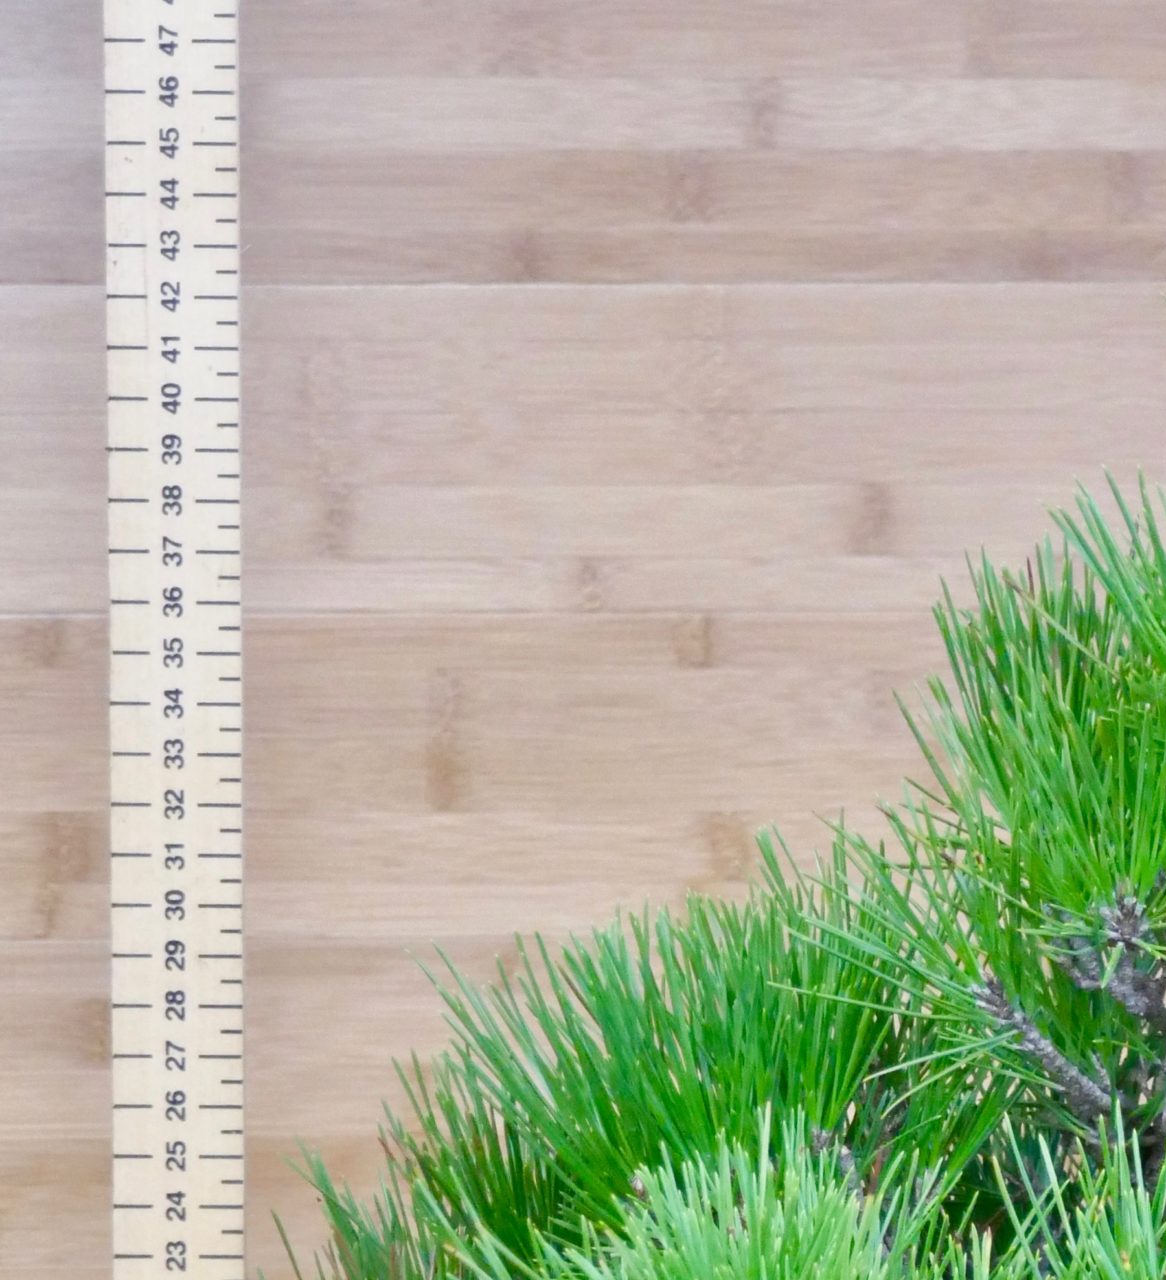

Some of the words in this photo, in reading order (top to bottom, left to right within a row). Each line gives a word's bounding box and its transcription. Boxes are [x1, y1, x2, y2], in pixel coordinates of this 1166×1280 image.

[158, 25, 178, 56] 47
[158, 76, 179, 107] 46
[159, 127, 179, 159] 45
[159, 178, 179, 210] 44
[160, 230, 180, 261] 43
[160, 281, 180, 312] 42
[161, 336, 180, 363] 41
[161, 383, 181, 414] 40
[161, 434, 182, 465] 39
[161, 485, 182, 516] 38
[162, 536, 183, 566] 37
[162, 586, 183, 618] 36
[163, 637, 184, 668] 35
[163, 688, 184, 719] 34
[163, 738, 184, 769] 33
[164, 789, 184, 820] 32
[164, 843, 185, 870] 31
[164, 889, 185, 921] 30
[164, 939, 185, 971] 29
[164, 990, 185, 1021] 28
[165, 1040, 185, 1071] 27
[165, 1090, 186, 1121] 26
[165, 1141, 186, 1171] 25
[165, 1191, 186, 1221] 24
[165, 1240, 186, 1271] 23
